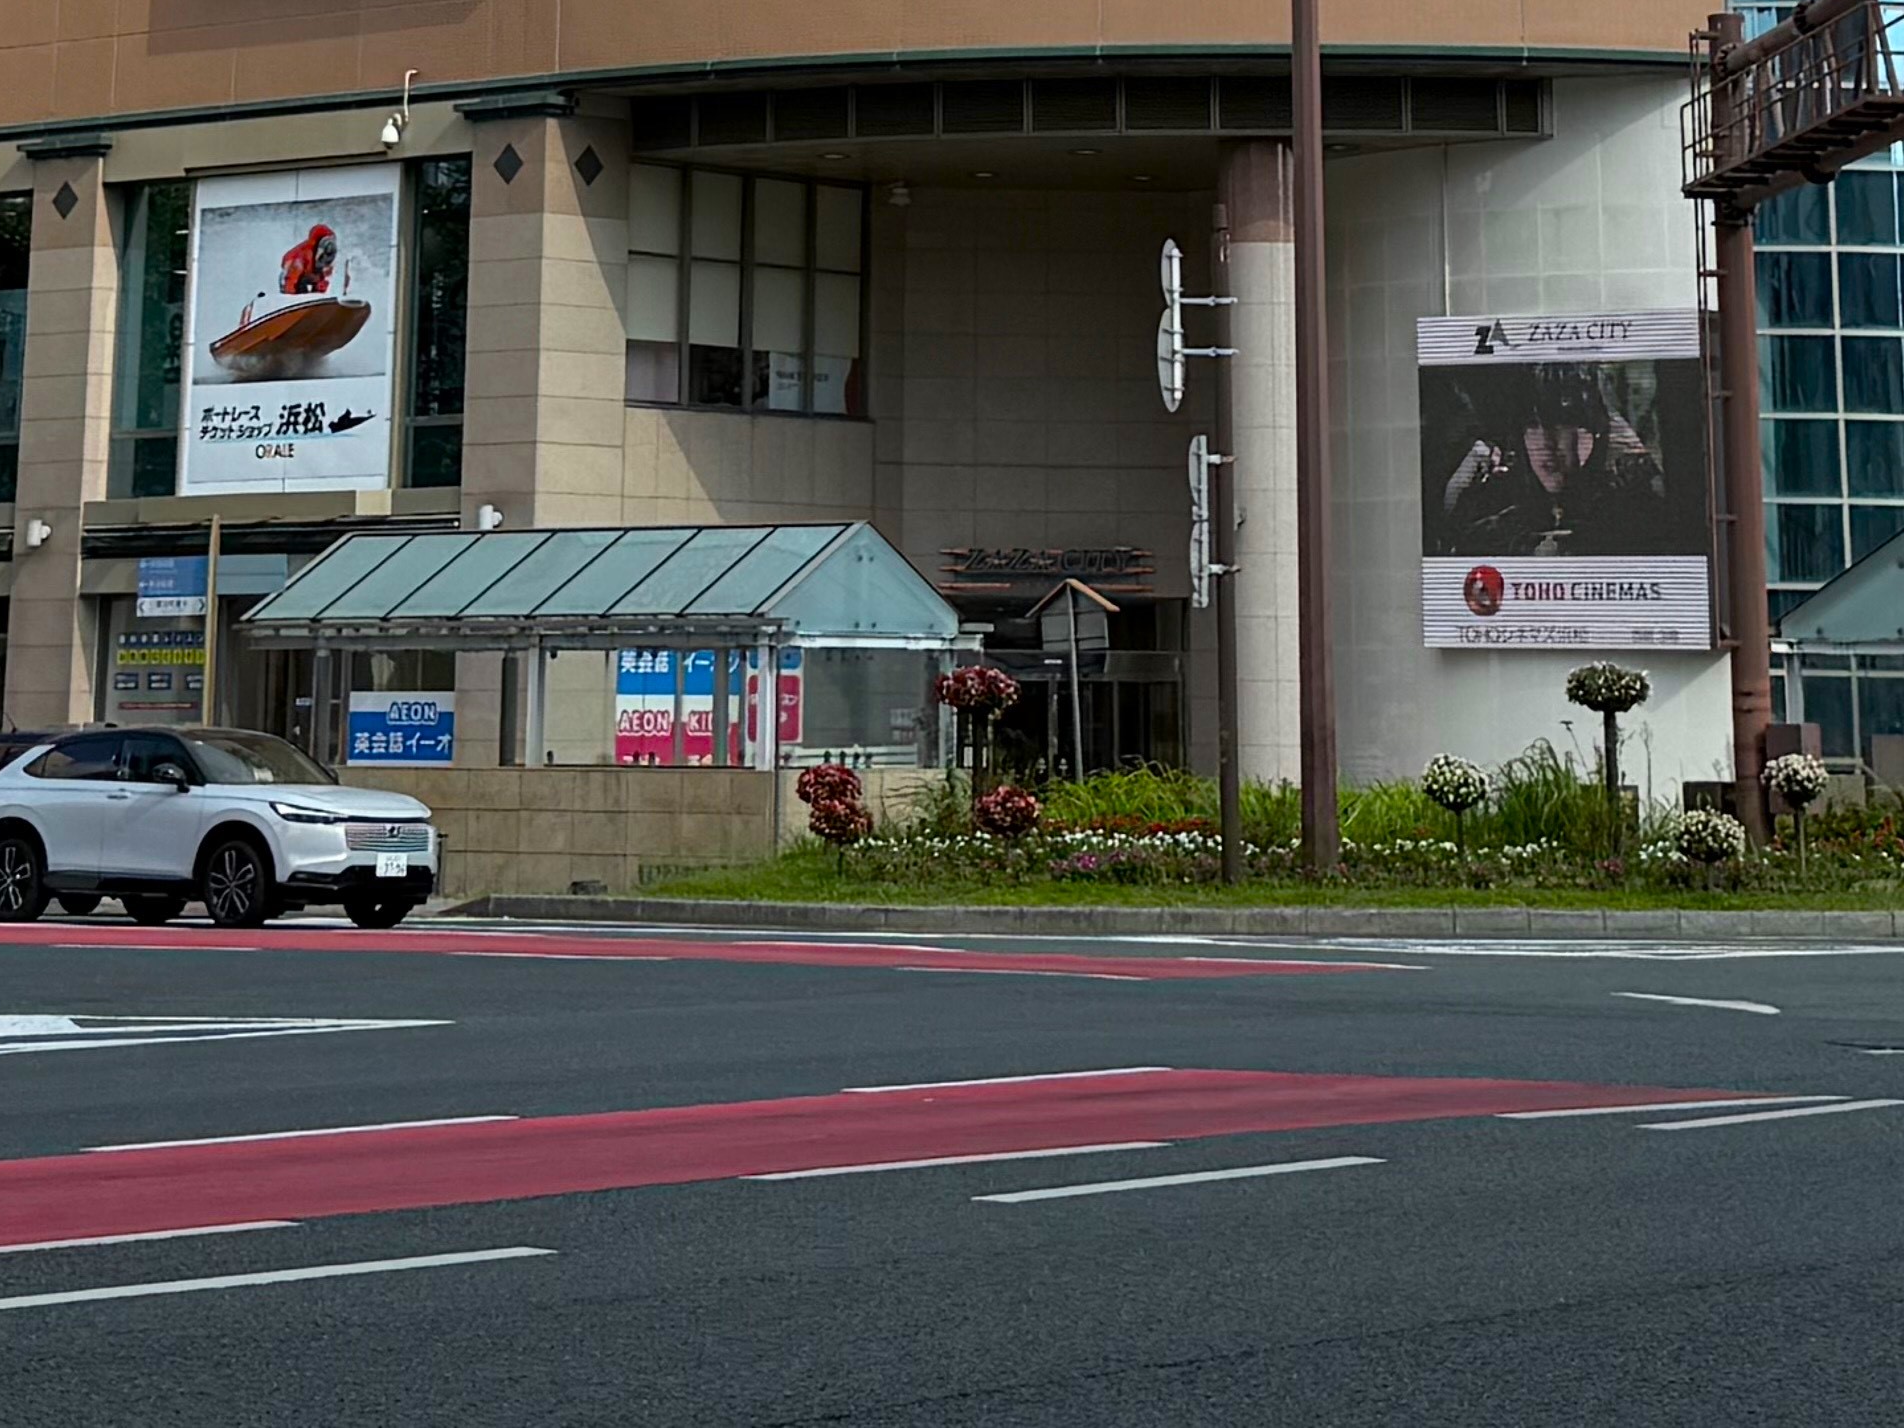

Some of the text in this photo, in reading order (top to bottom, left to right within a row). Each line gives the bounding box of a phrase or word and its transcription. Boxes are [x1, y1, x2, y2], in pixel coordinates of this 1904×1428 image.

[1527, 319, 1633, 342] ZAZA CITY
[276, 402, 326, 435] 浜松
[1511, 581, 1662, 601] TOHO CINEMAS
[388, 701, 438, 723] AEON
[618, 710, 670, 732] AEON
